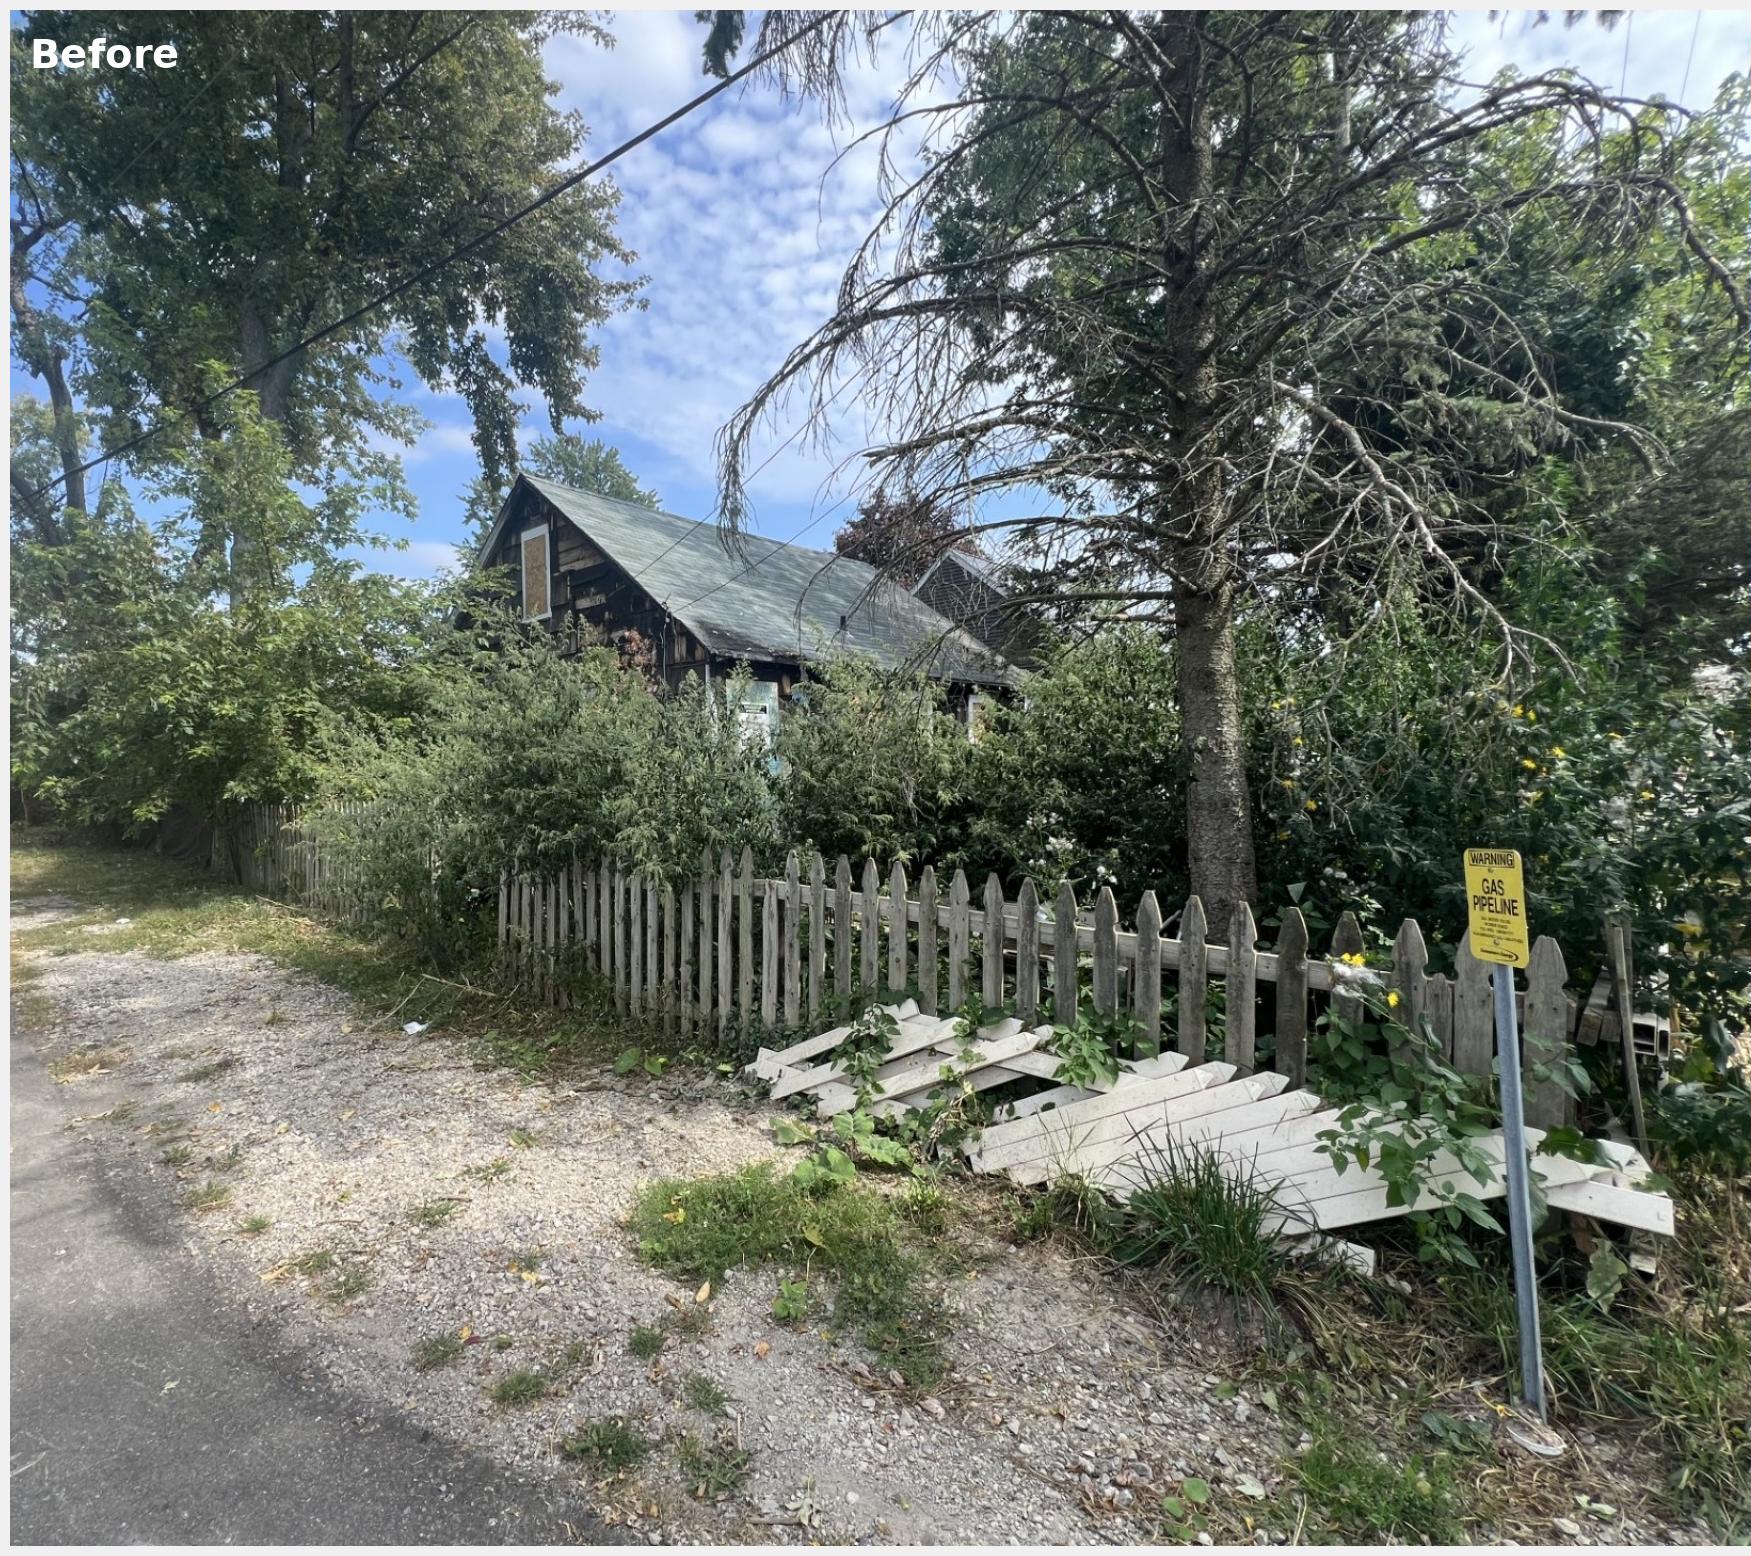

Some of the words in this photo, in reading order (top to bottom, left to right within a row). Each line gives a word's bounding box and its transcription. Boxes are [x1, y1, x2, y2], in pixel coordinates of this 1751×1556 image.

[1470, 852, 1513, 866] WARNING
[1481, 878, 1505, 896] GAS
[1473, 895, 1519, 916] PIPELINE
